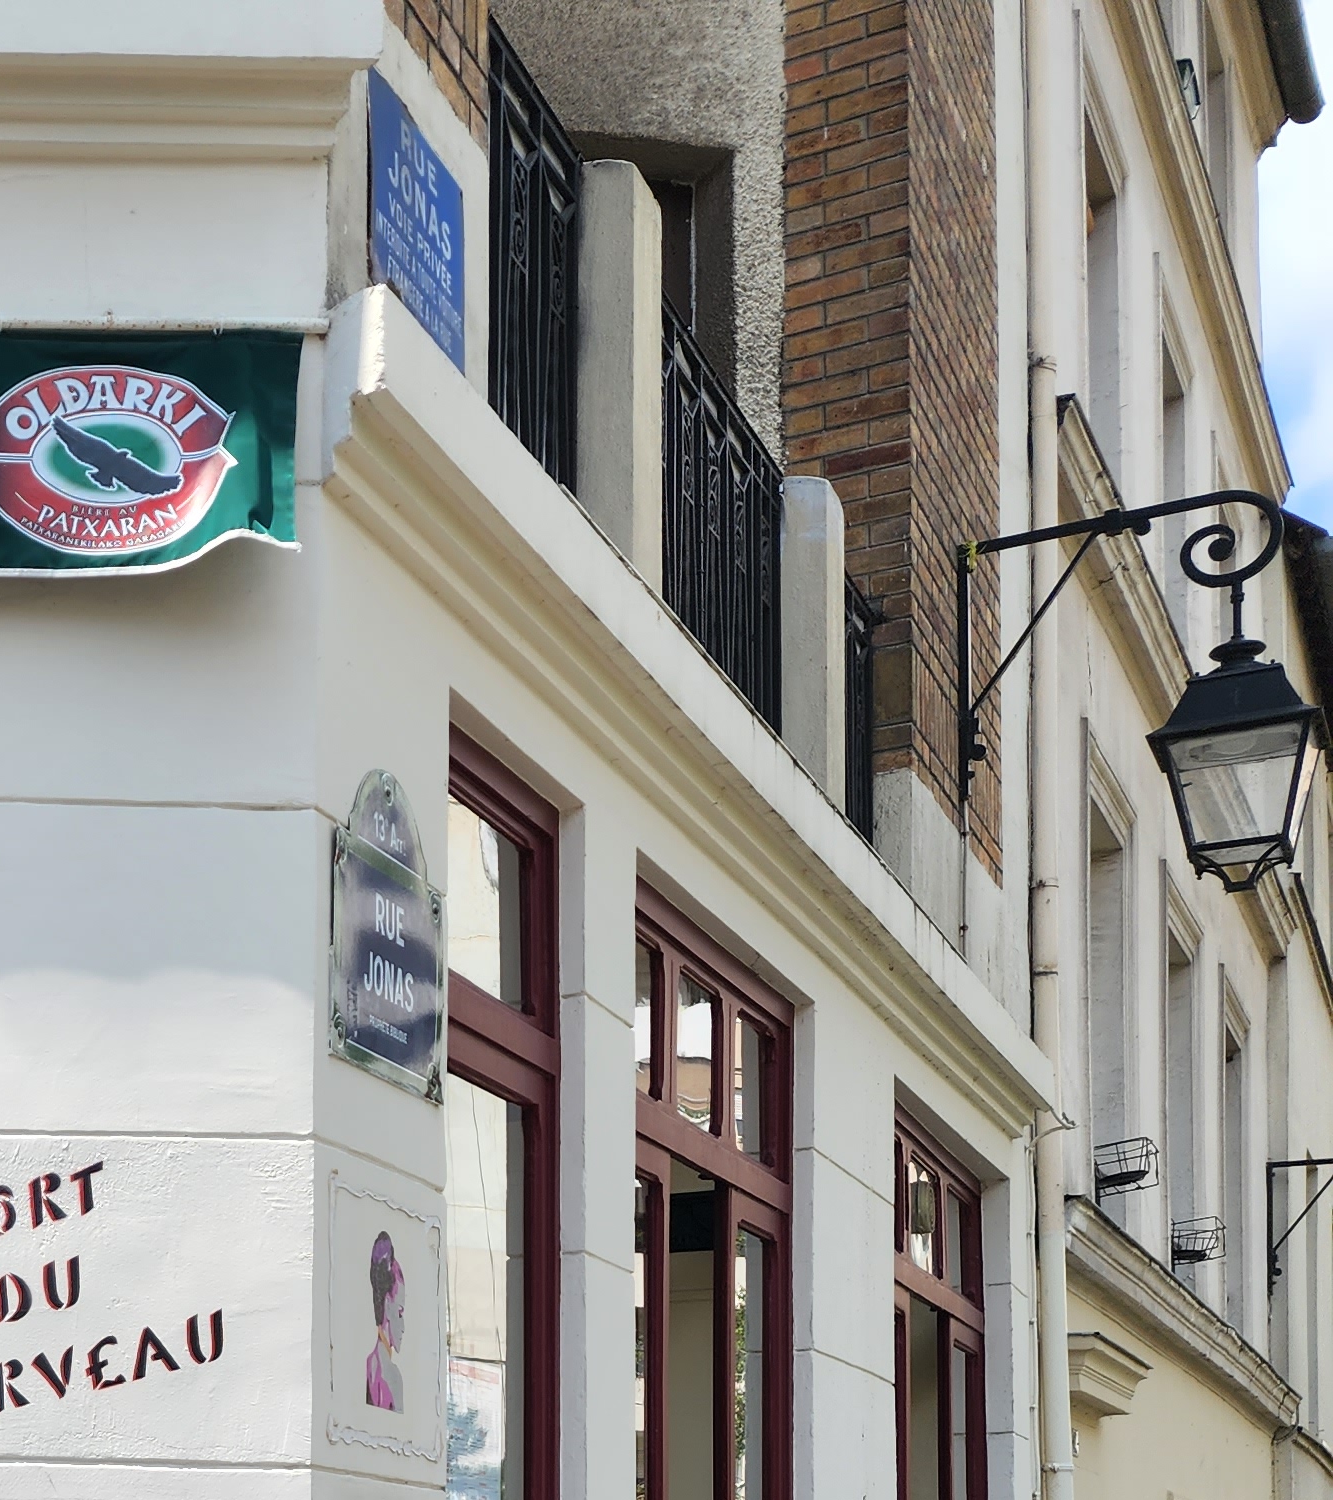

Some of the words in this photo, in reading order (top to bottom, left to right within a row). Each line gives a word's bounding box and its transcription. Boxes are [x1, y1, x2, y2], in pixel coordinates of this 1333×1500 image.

[400, 118, 438, 197] RUE
[388, 152, 452, 261] JONAS
[388, 191, 414, 243] VOIE
[416, 232, 452, 296] PRIVÉE
[4, 374, 208, 440] OLDARKI
[36, 503, 179, 538] PATXARAN
[375, 892, 405, 948] RUE
[364, 951, 414, 1013] JONAS
